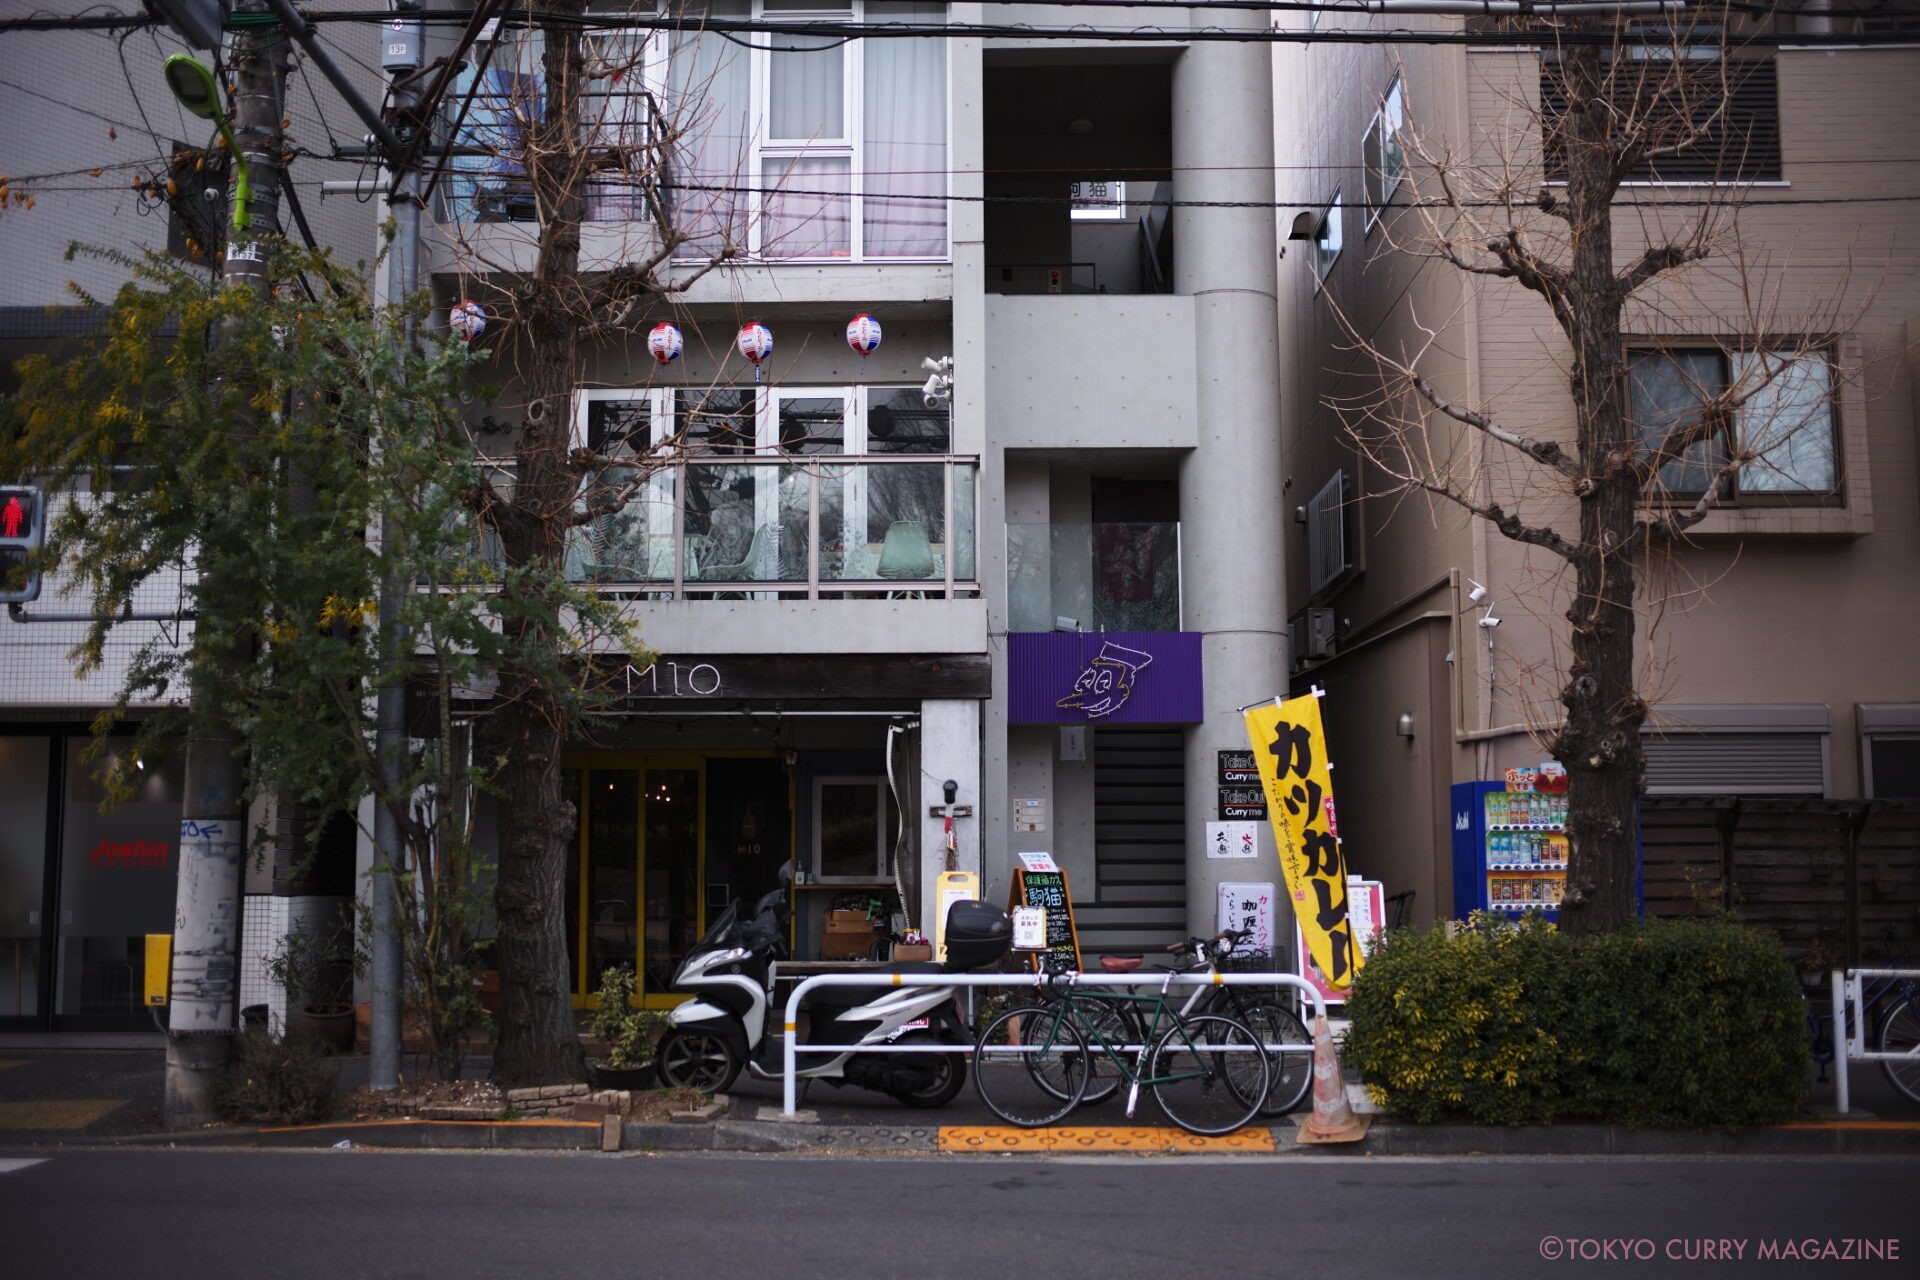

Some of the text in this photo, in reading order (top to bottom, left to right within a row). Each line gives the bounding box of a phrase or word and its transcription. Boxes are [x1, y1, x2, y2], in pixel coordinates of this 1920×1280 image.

[1225, 772, 1247, 781] Curry
[1508, 771, 1534, 782] ホッと
[1220, 789, 1247, 804] Take
[1225, 807, 1247, 817] Curry
[1269, 721, 1348, 981] カツカレー
[1028, 887, 1062, 906] 駒猫
[1258, 895, 1268, 951] カレーハウス
